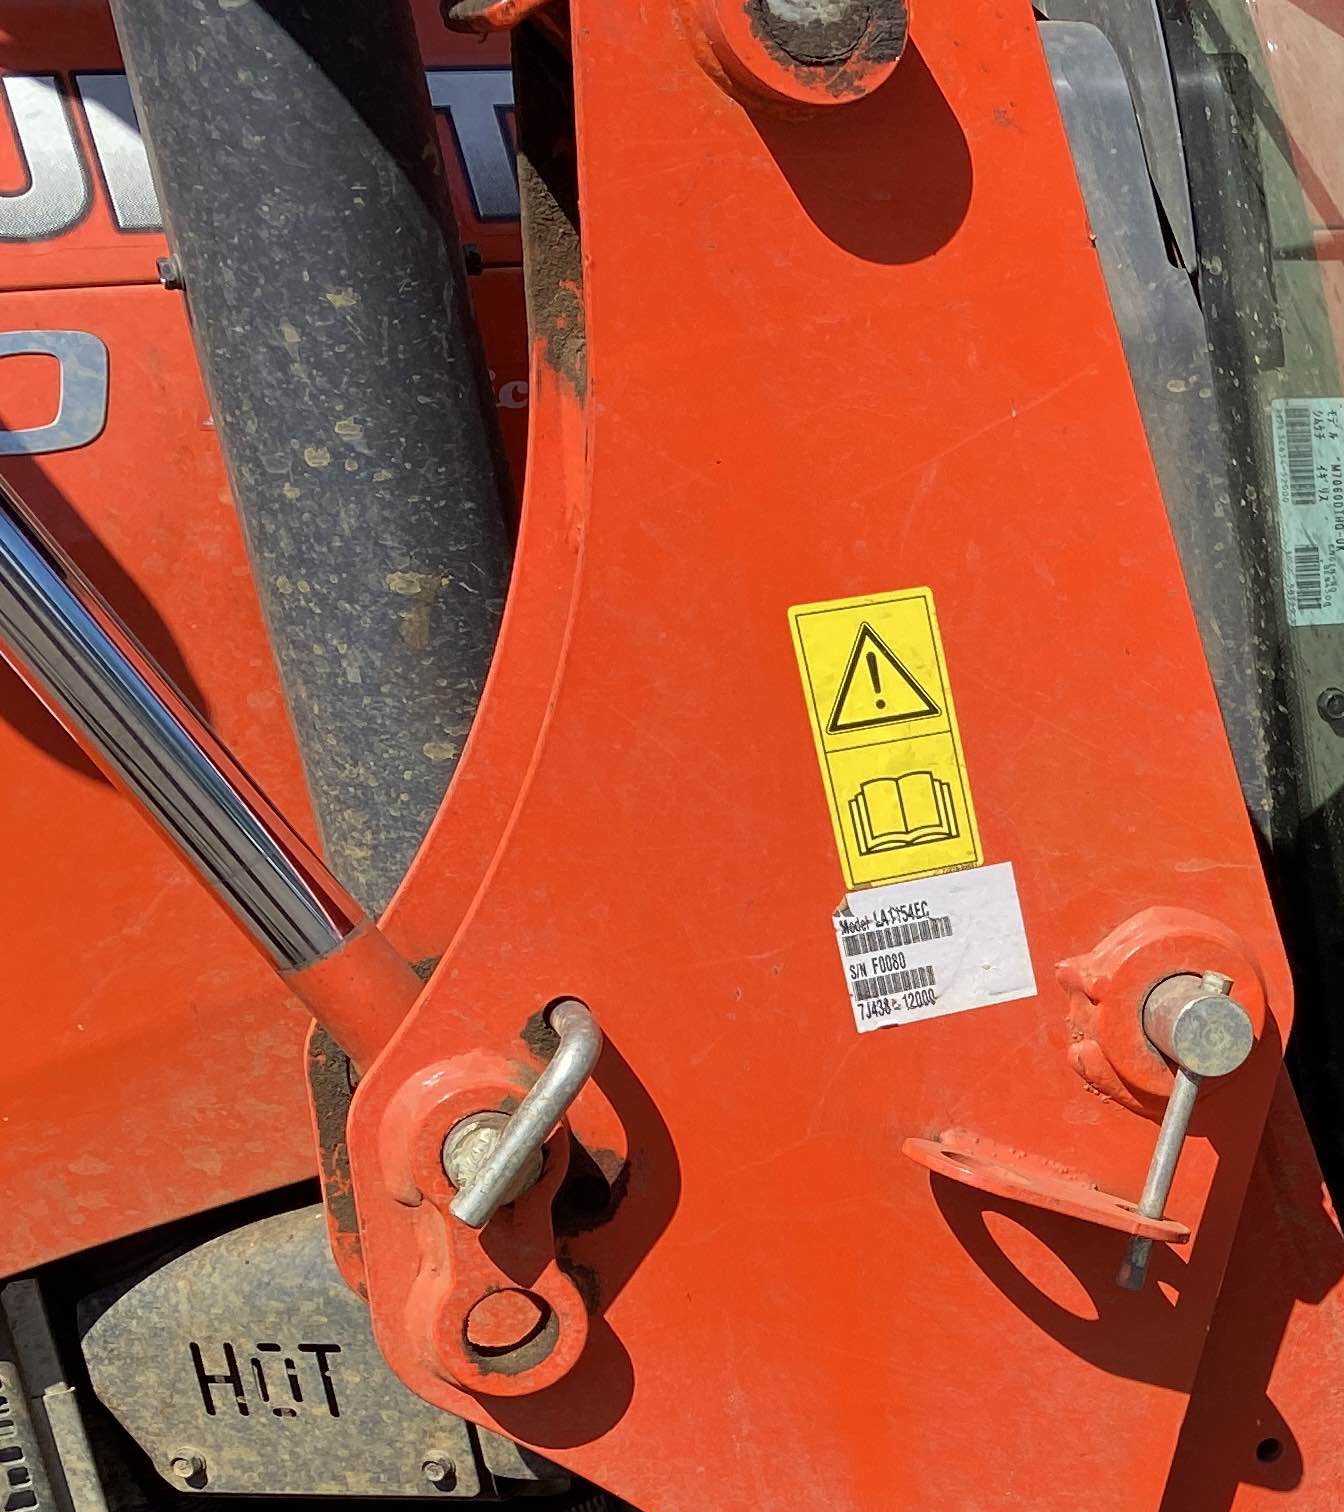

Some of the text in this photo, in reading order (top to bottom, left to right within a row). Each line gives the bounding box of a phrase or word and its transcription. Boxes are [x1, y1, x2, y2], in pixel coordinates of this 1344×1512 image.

[849, 951, 907, 980] S/N F0080
[189, 1342, 341, 1417] HOT
